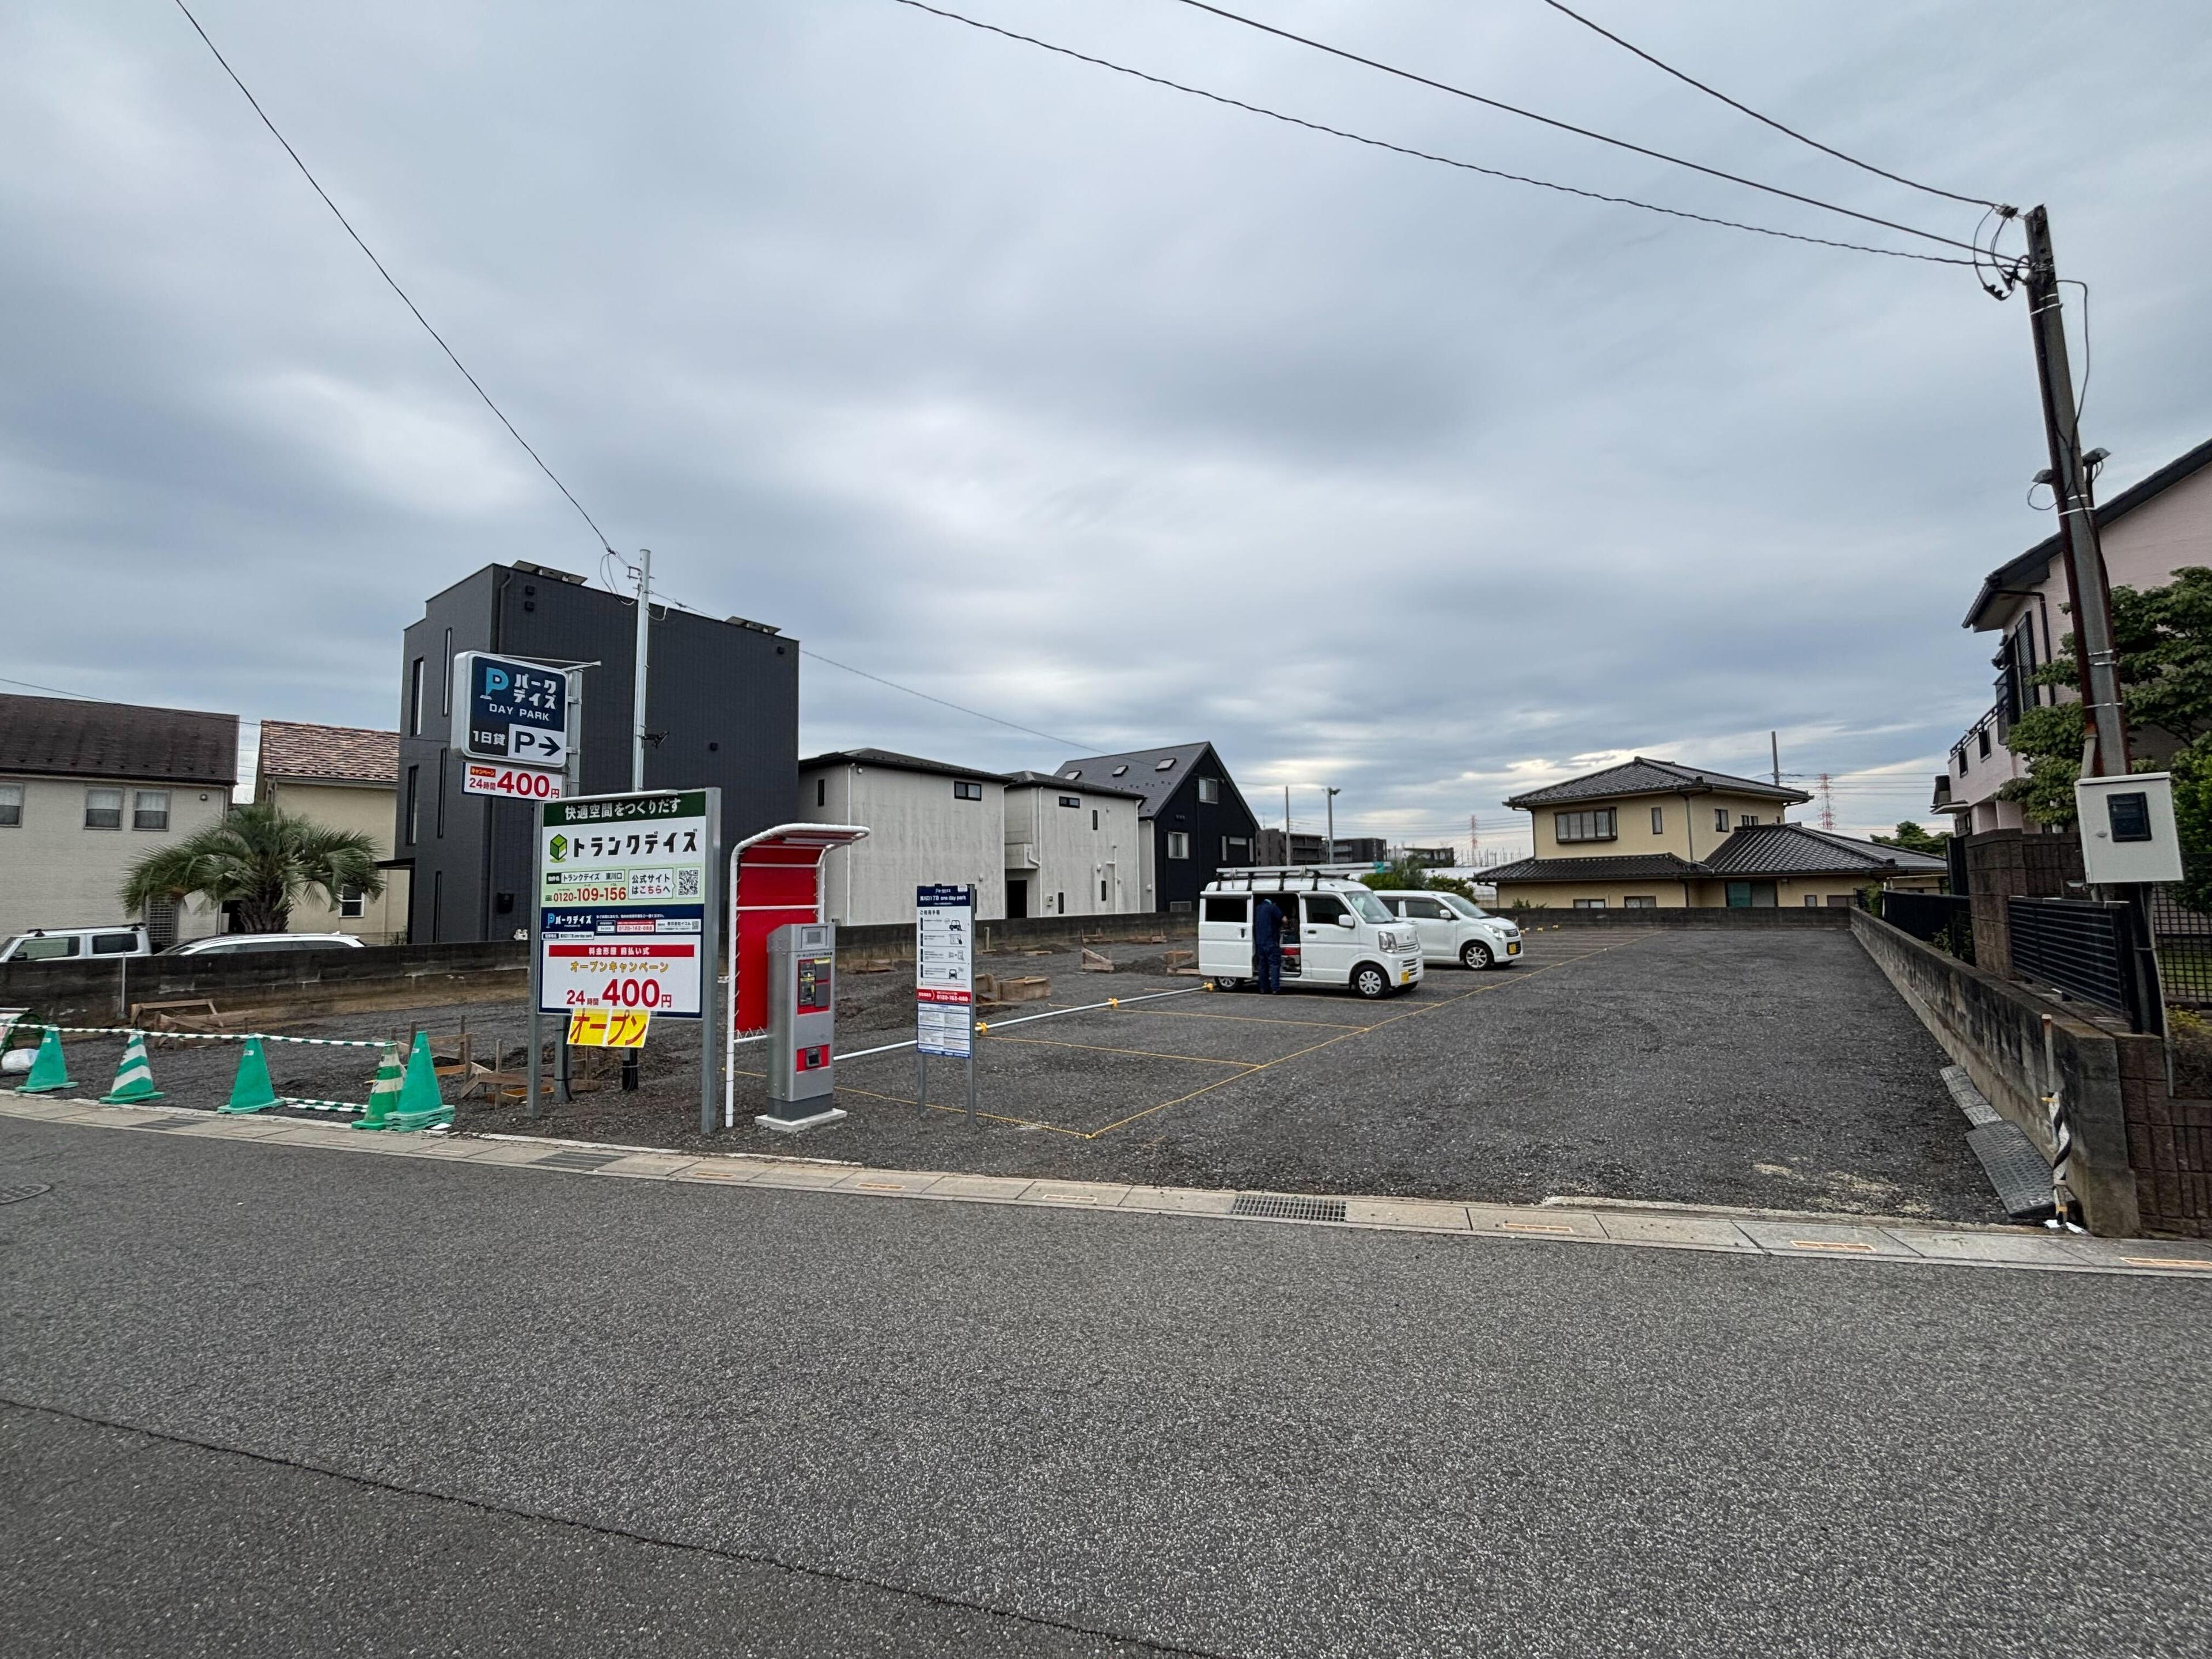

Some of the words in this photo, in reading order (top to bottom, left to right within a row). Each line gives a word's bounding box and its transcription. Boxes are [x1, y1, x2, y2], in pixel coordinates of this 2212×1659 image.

[514, 673, 556, 694] パーク
[513, 688, 556, 709] デイズ
[489, 703, 513, 715] DAY
[519, 709, 550, 721] PARK
[472, 730, 505, 746] 1日貸
[514, 730, 535, 753] P
[565, 797, 681, 821] 快適空間をつくりだす
[574, 828, 698, 858] トランクデイズ
[563, 873, 600, 881] トランクデイズ
[605, 872, 623, 880] 東川口
[632, 873, 670, 884] 公式サイト
[553, 887, 626, 902] 0120-109-156
[632, 885, 671, 895] はこちらへ
[555, 915, 592, 925] パークデイズ
[570, 960, 669, 973] オープンキャンペーン
[570, 1008, 646, 1046] オープン
